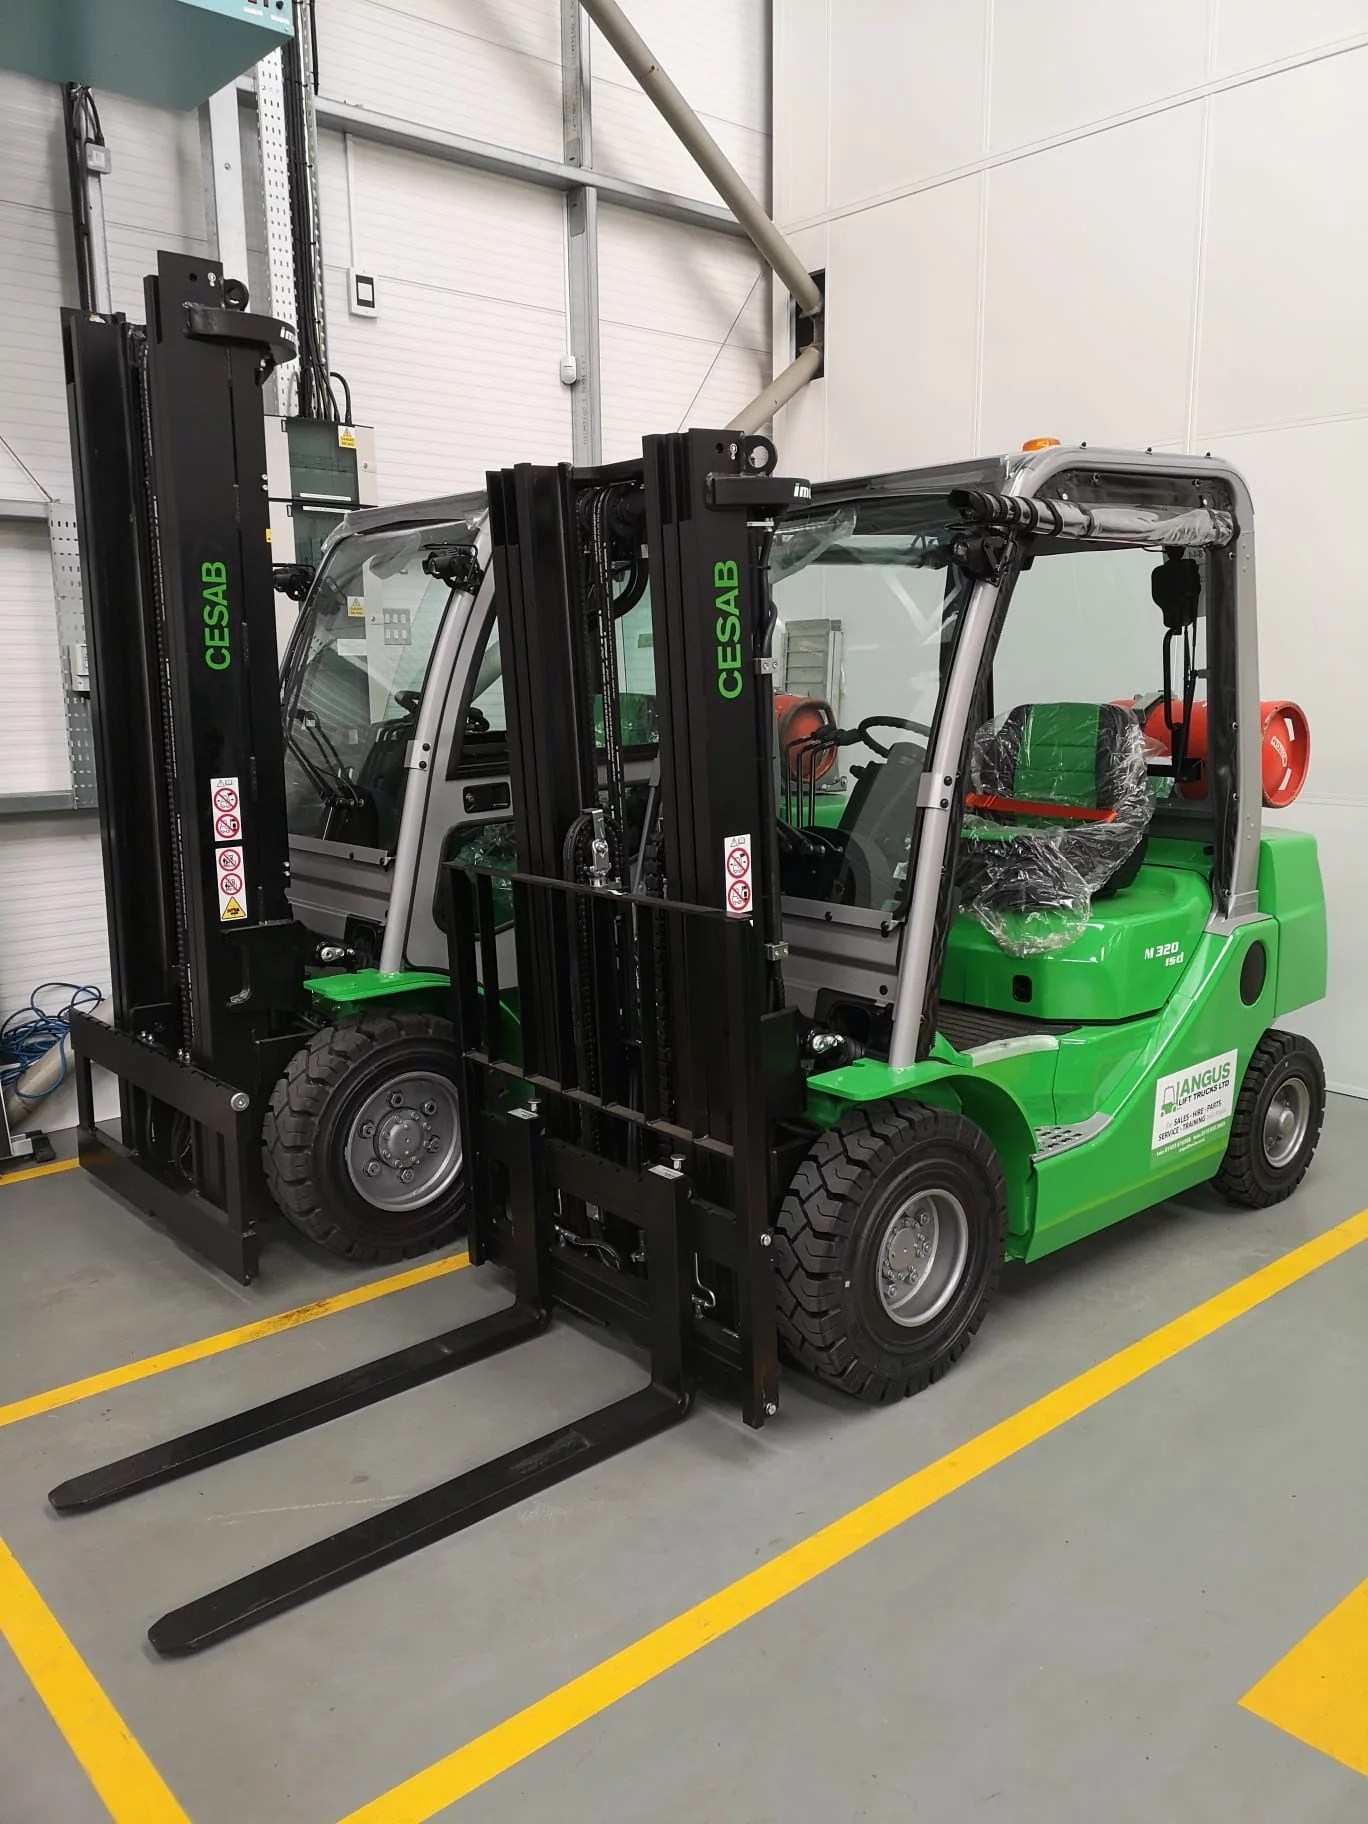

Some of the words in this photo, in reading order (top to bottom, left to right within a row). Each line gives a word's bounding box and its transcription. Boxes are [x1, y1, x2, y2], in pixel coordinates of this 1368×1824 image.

[280, 326, 297, 344] im
[201, 561, 231, 671] CESAB
[714, 560, 743, 699] CESAB
[1144, 947, 1155, 961] M
[1155, 941, 1180, 958] 320
[1178, 1094, 1192, 1106] LIFT
[1193, 1084, 1218, 1100] TRUCKS
[1218, 1079, 1230, 1090] LTD
[1180, 1062, 1231, 1097] ANGUS
[1174, 1113, 1190, 1126] SALES
[1192, 1107, 1204, 1118] HIRE
[1206, 1099, 1222, 1112] PARTS
[1158, 1126, 1180, 1142] SERVICE
[1182, 1115, 1206, 1130] TRAINING
